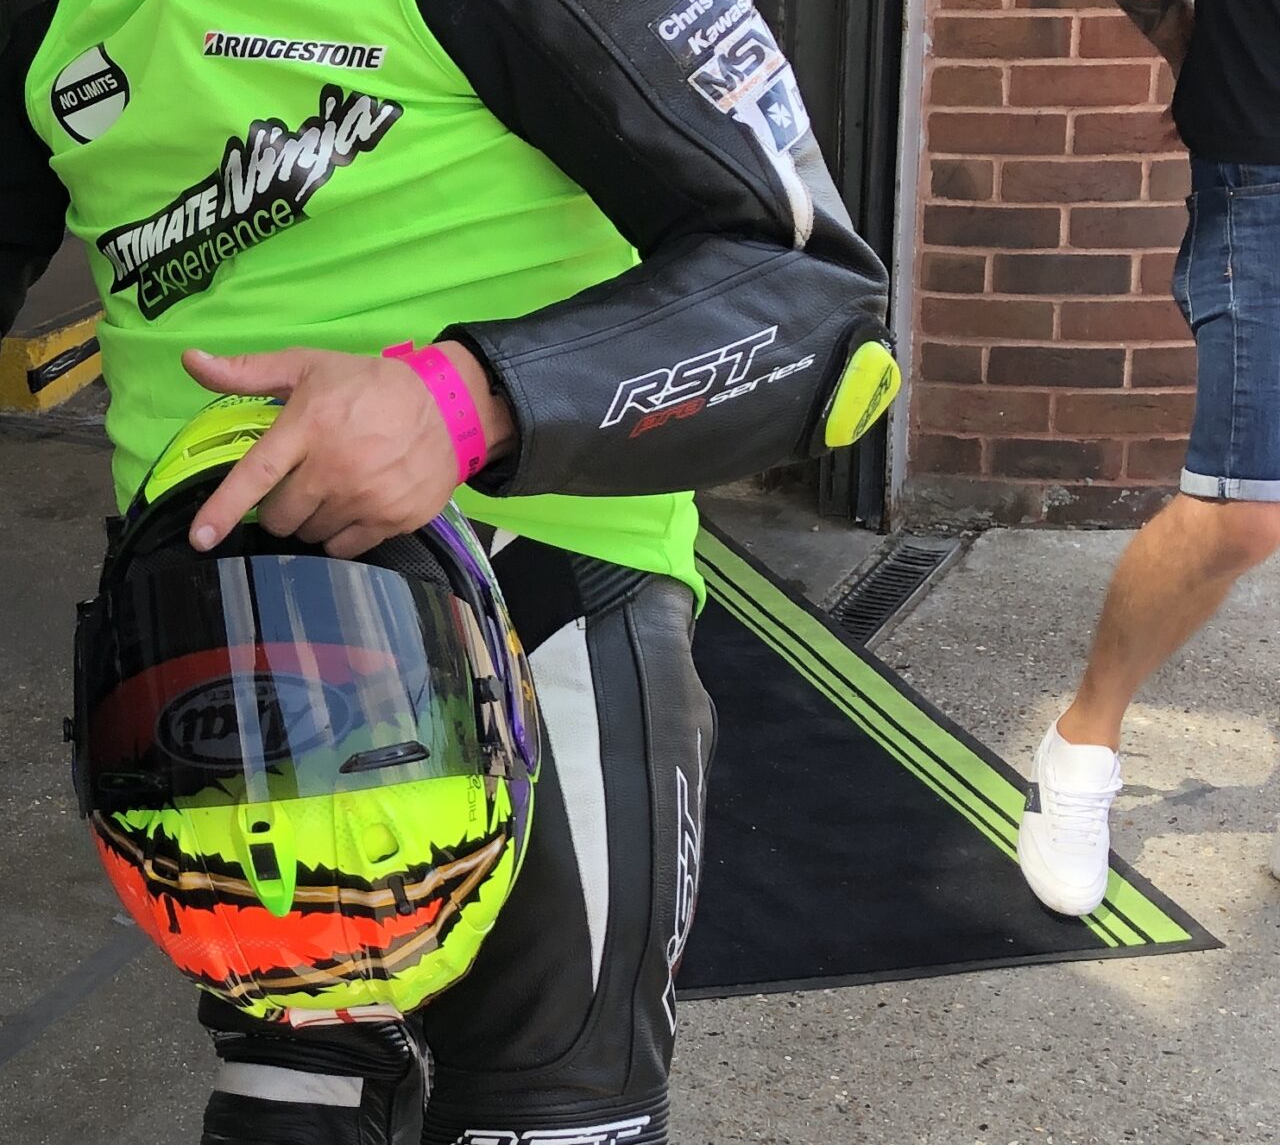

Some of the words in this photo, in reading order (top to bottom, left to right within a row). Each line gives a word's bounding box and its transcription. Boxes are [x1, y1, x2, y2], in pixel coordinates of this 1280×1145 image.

[203, 32, 384, 69] BRIDGESTONE
[58, 89, 79, 111] NO
[78, 73, 119, 103] LIMITS
[221, 95, 395, 220] Ninja
[140, 198, 295, 307] Experience
[598, 324, 779, 429] RST
[706, 353, 816, 408] series
